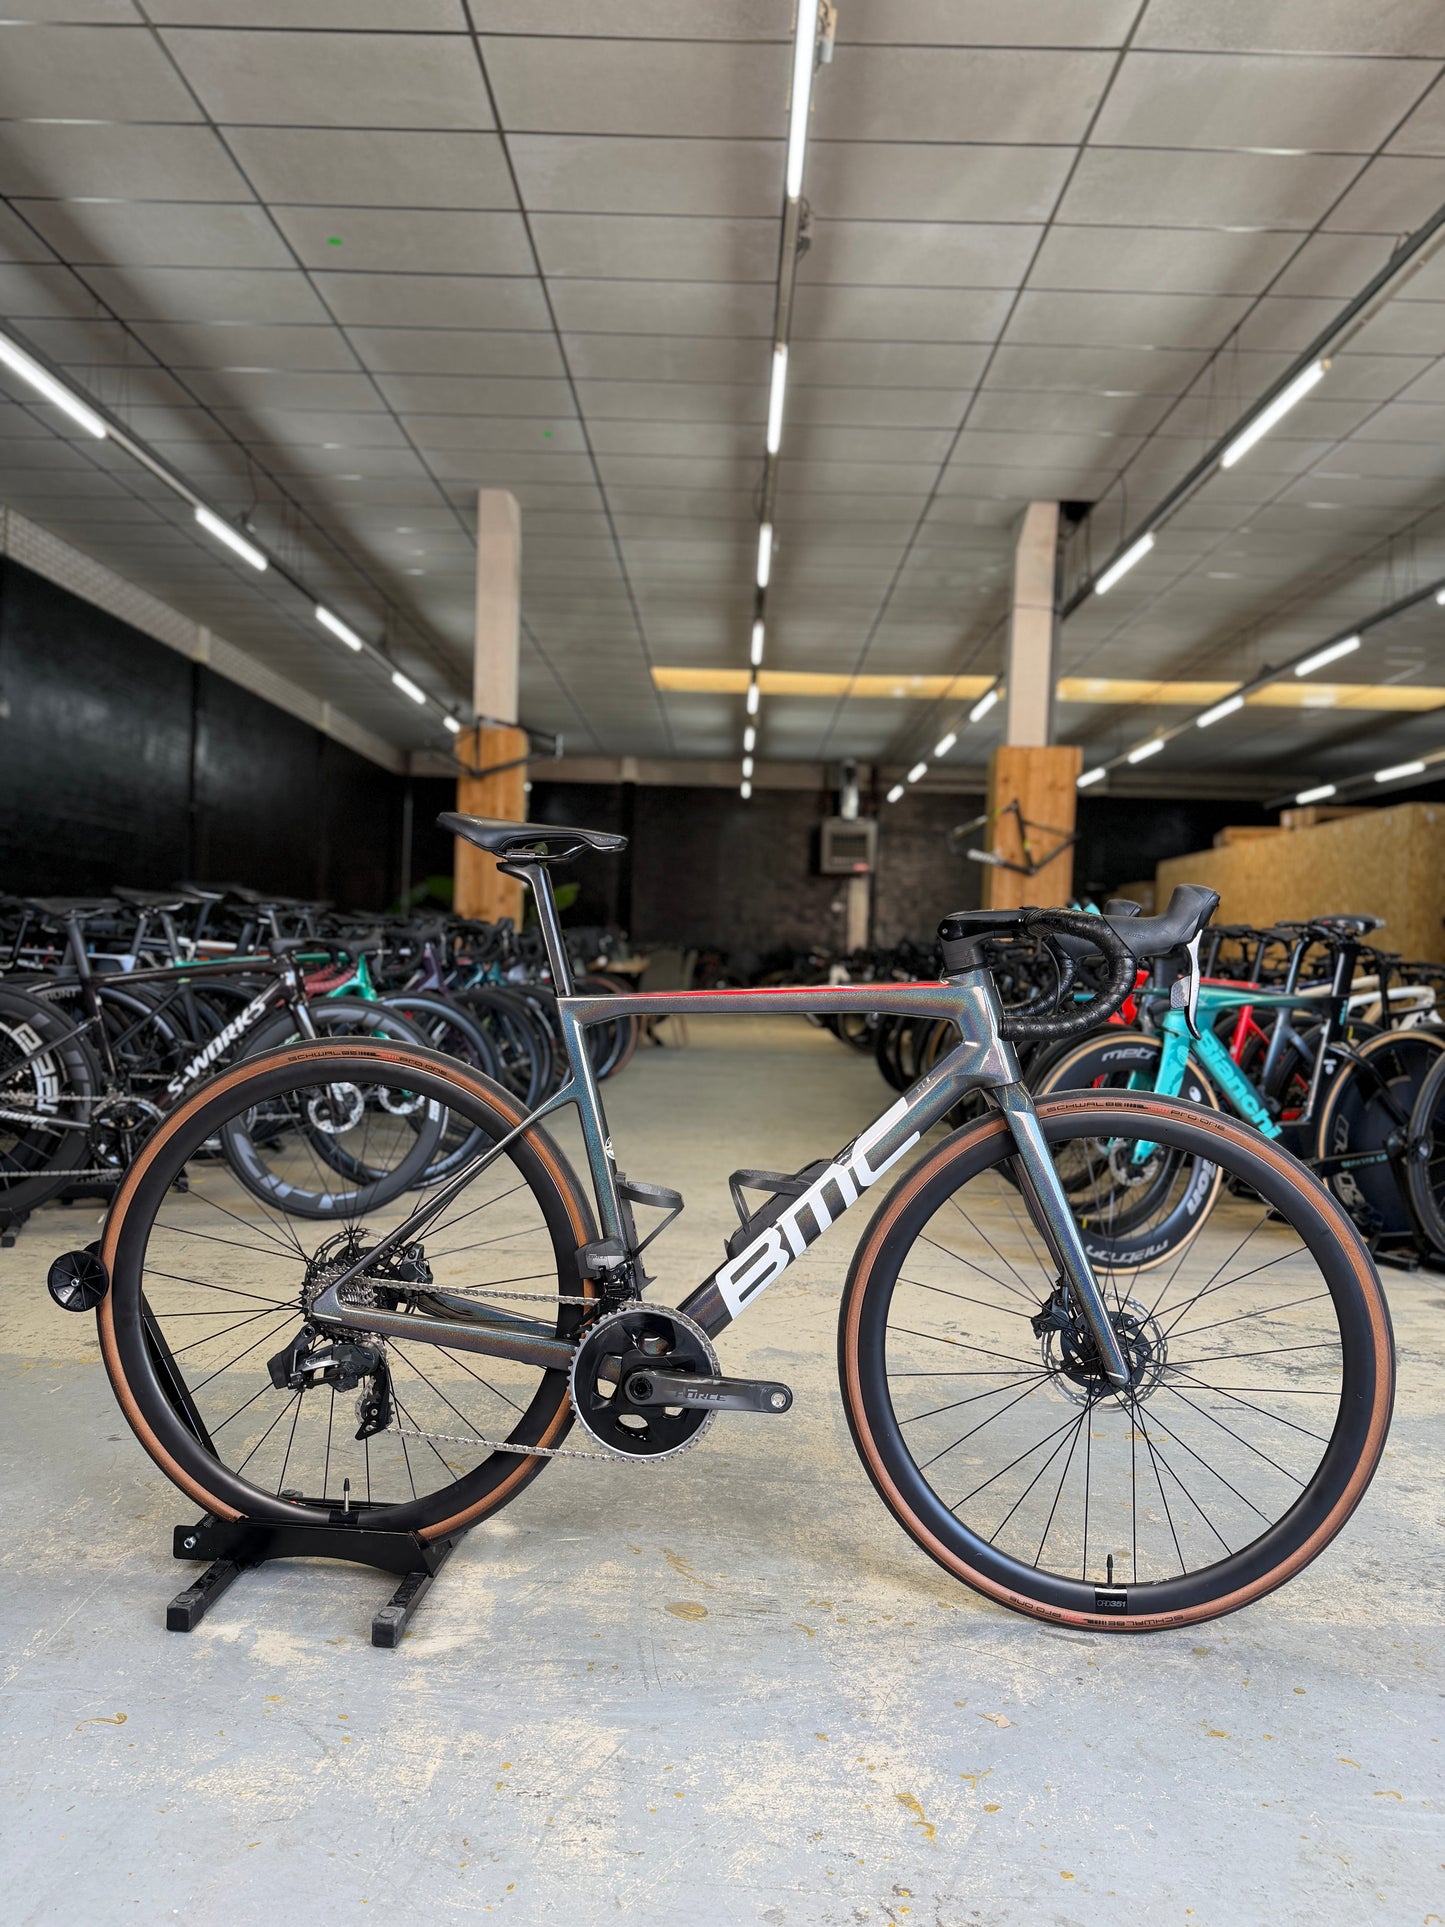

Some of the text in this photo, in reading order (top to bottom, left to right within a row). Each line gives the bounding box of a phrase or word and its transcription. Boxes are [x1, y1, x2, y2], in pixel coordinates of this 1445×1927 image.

[167, 992, 267, 1100] S-WORKS
[288, 1051, 357, 1062] SCHWALBE
[1101, 1047, 1158, 1063] metr
[1198, 1028, 1283, 1139] Bianchi
[1046, 1101, 1125, 1113] SCHWALBE
[715, 1097, 921, 1320] BMC
[675, 1388, 726, 1402] FORCE
[1108, 1614, 1185, 1627] SCHWALBE
